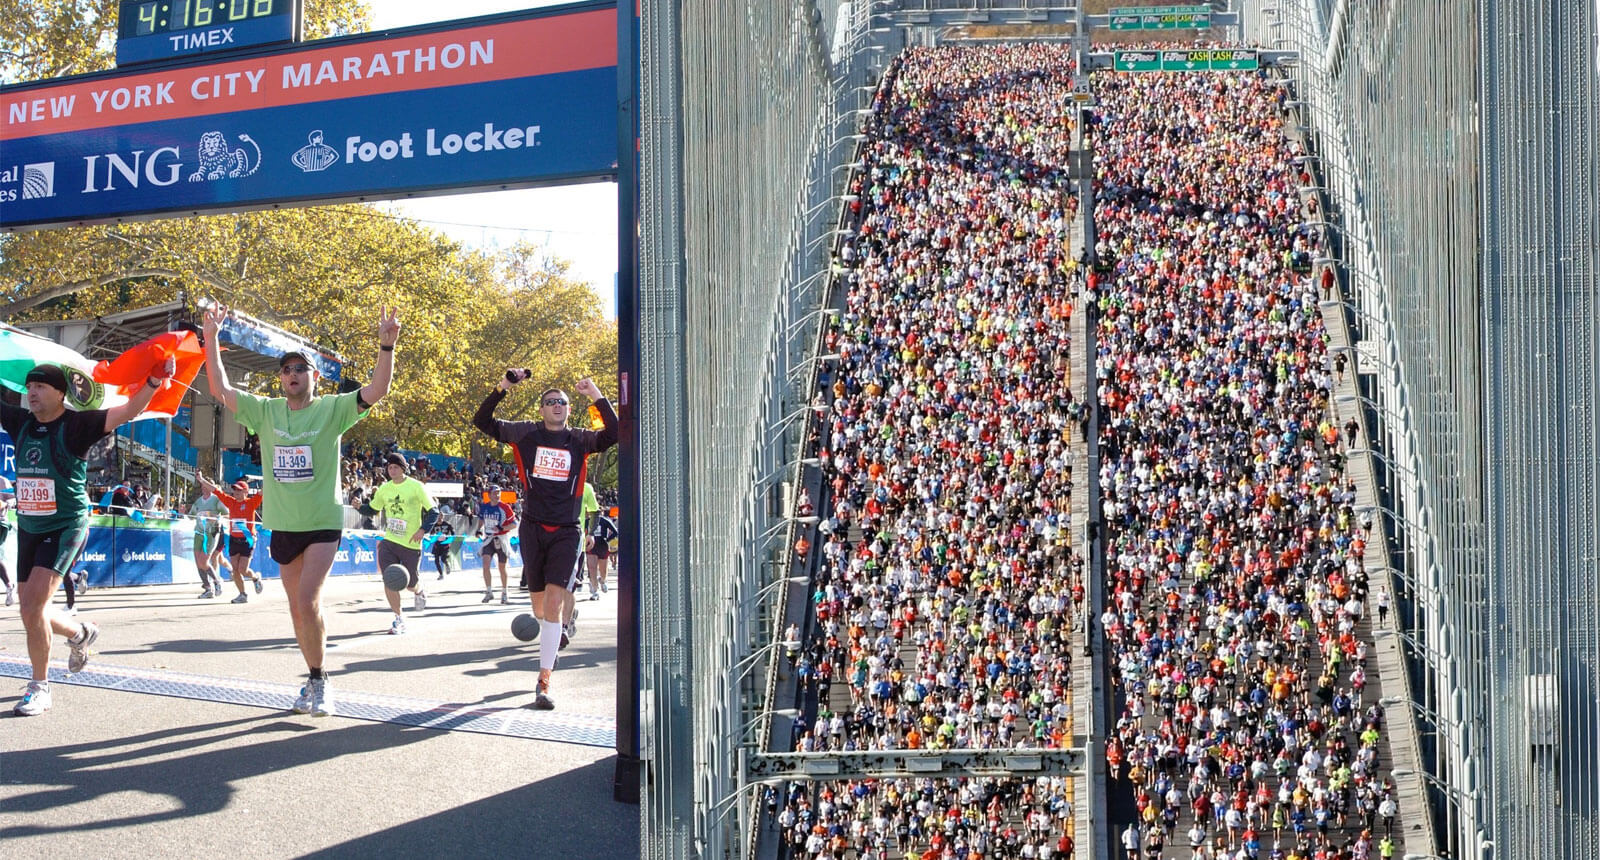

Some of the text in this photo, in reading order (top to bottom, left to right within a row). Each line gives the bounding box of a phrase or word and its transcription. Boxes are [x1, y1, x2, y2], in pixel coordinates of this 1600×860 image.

[170, 27, 234, 51] TIMEX
[1188, 51, 1209, 61] CASH
[1212, 51, 1231, 60] CASH
[9, 39, 494, 124] NEW YORK CITY MARATHON
[1075, 85, 1088, 93] 45
[346, 123, 541, 164] Foot Locker
[81, 146, 183, 194] ING
[278, 455, 306, 468] 11-349
[539, 456, 566, 468] 15-756
[21, 488, 49, 500] 12-199
[85, 551, 106, 561] Locker
[131, 552, 166, 561] Foot Locker
